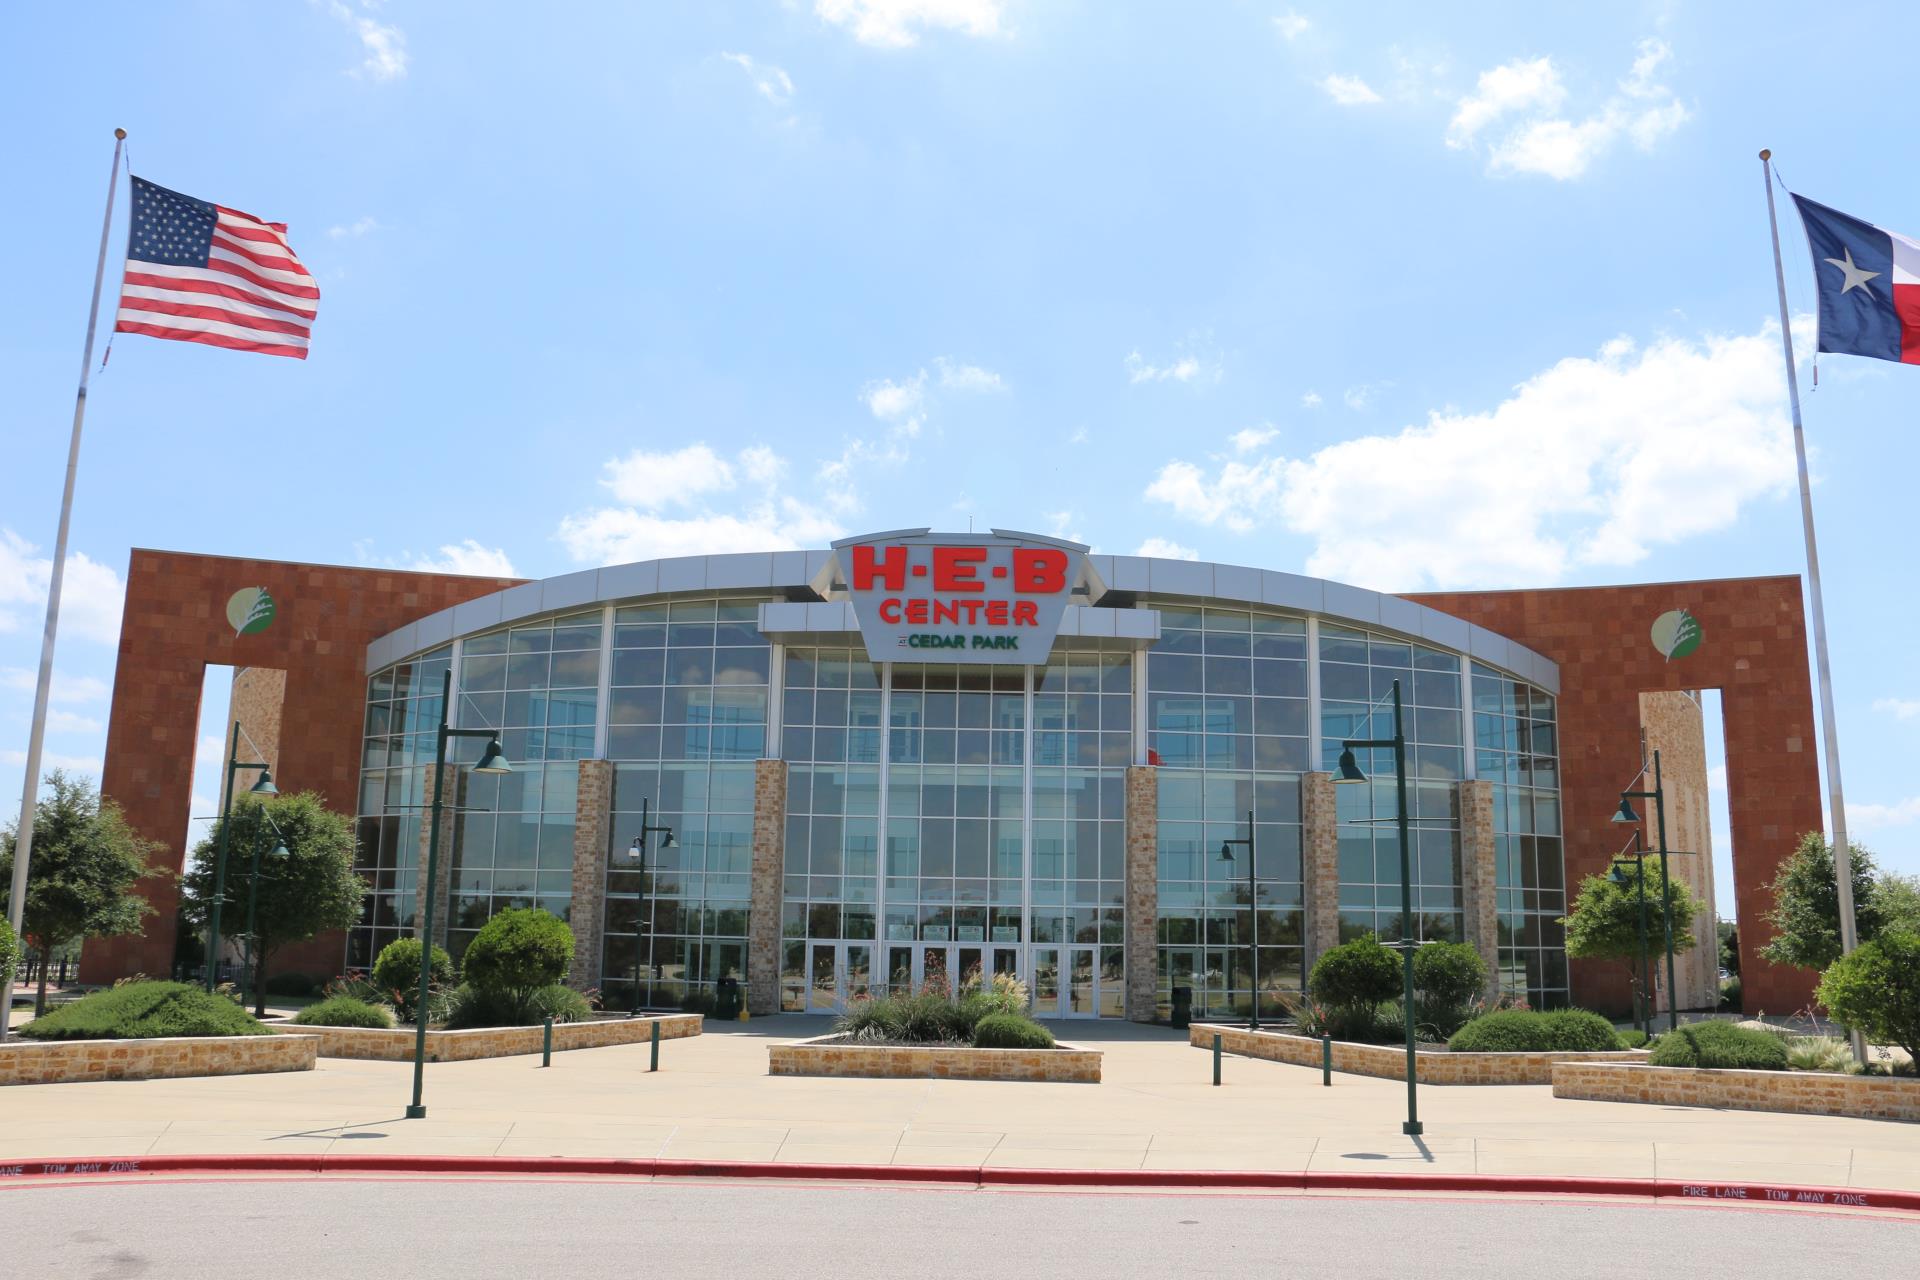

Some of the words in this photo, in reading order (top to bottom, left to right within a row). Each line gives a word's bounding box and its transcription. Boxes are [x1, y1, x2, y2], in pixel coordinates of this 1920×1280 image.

[879, 598, 1039, 626] CENTER
[908, 634, 966, 649] CEDAR
[972, 635, 1019, 649] PARK
[0, 1165, 24, 1175] ANE
[43, 1164, 66, 1174] TOW
[73, 1163, 101, 1173] AWAY
[108, 1161, 140, 1173] ZONE
[1682, 1185, 1709, 1197] FIRE
[1715, 1187, 1747, 1199] LANE
[1765, 1189, 1789, 1201] TOW
[1796, 1191, 1825, 1203] AWAY
[1832, 1193, 1868, 1206] ZONE
